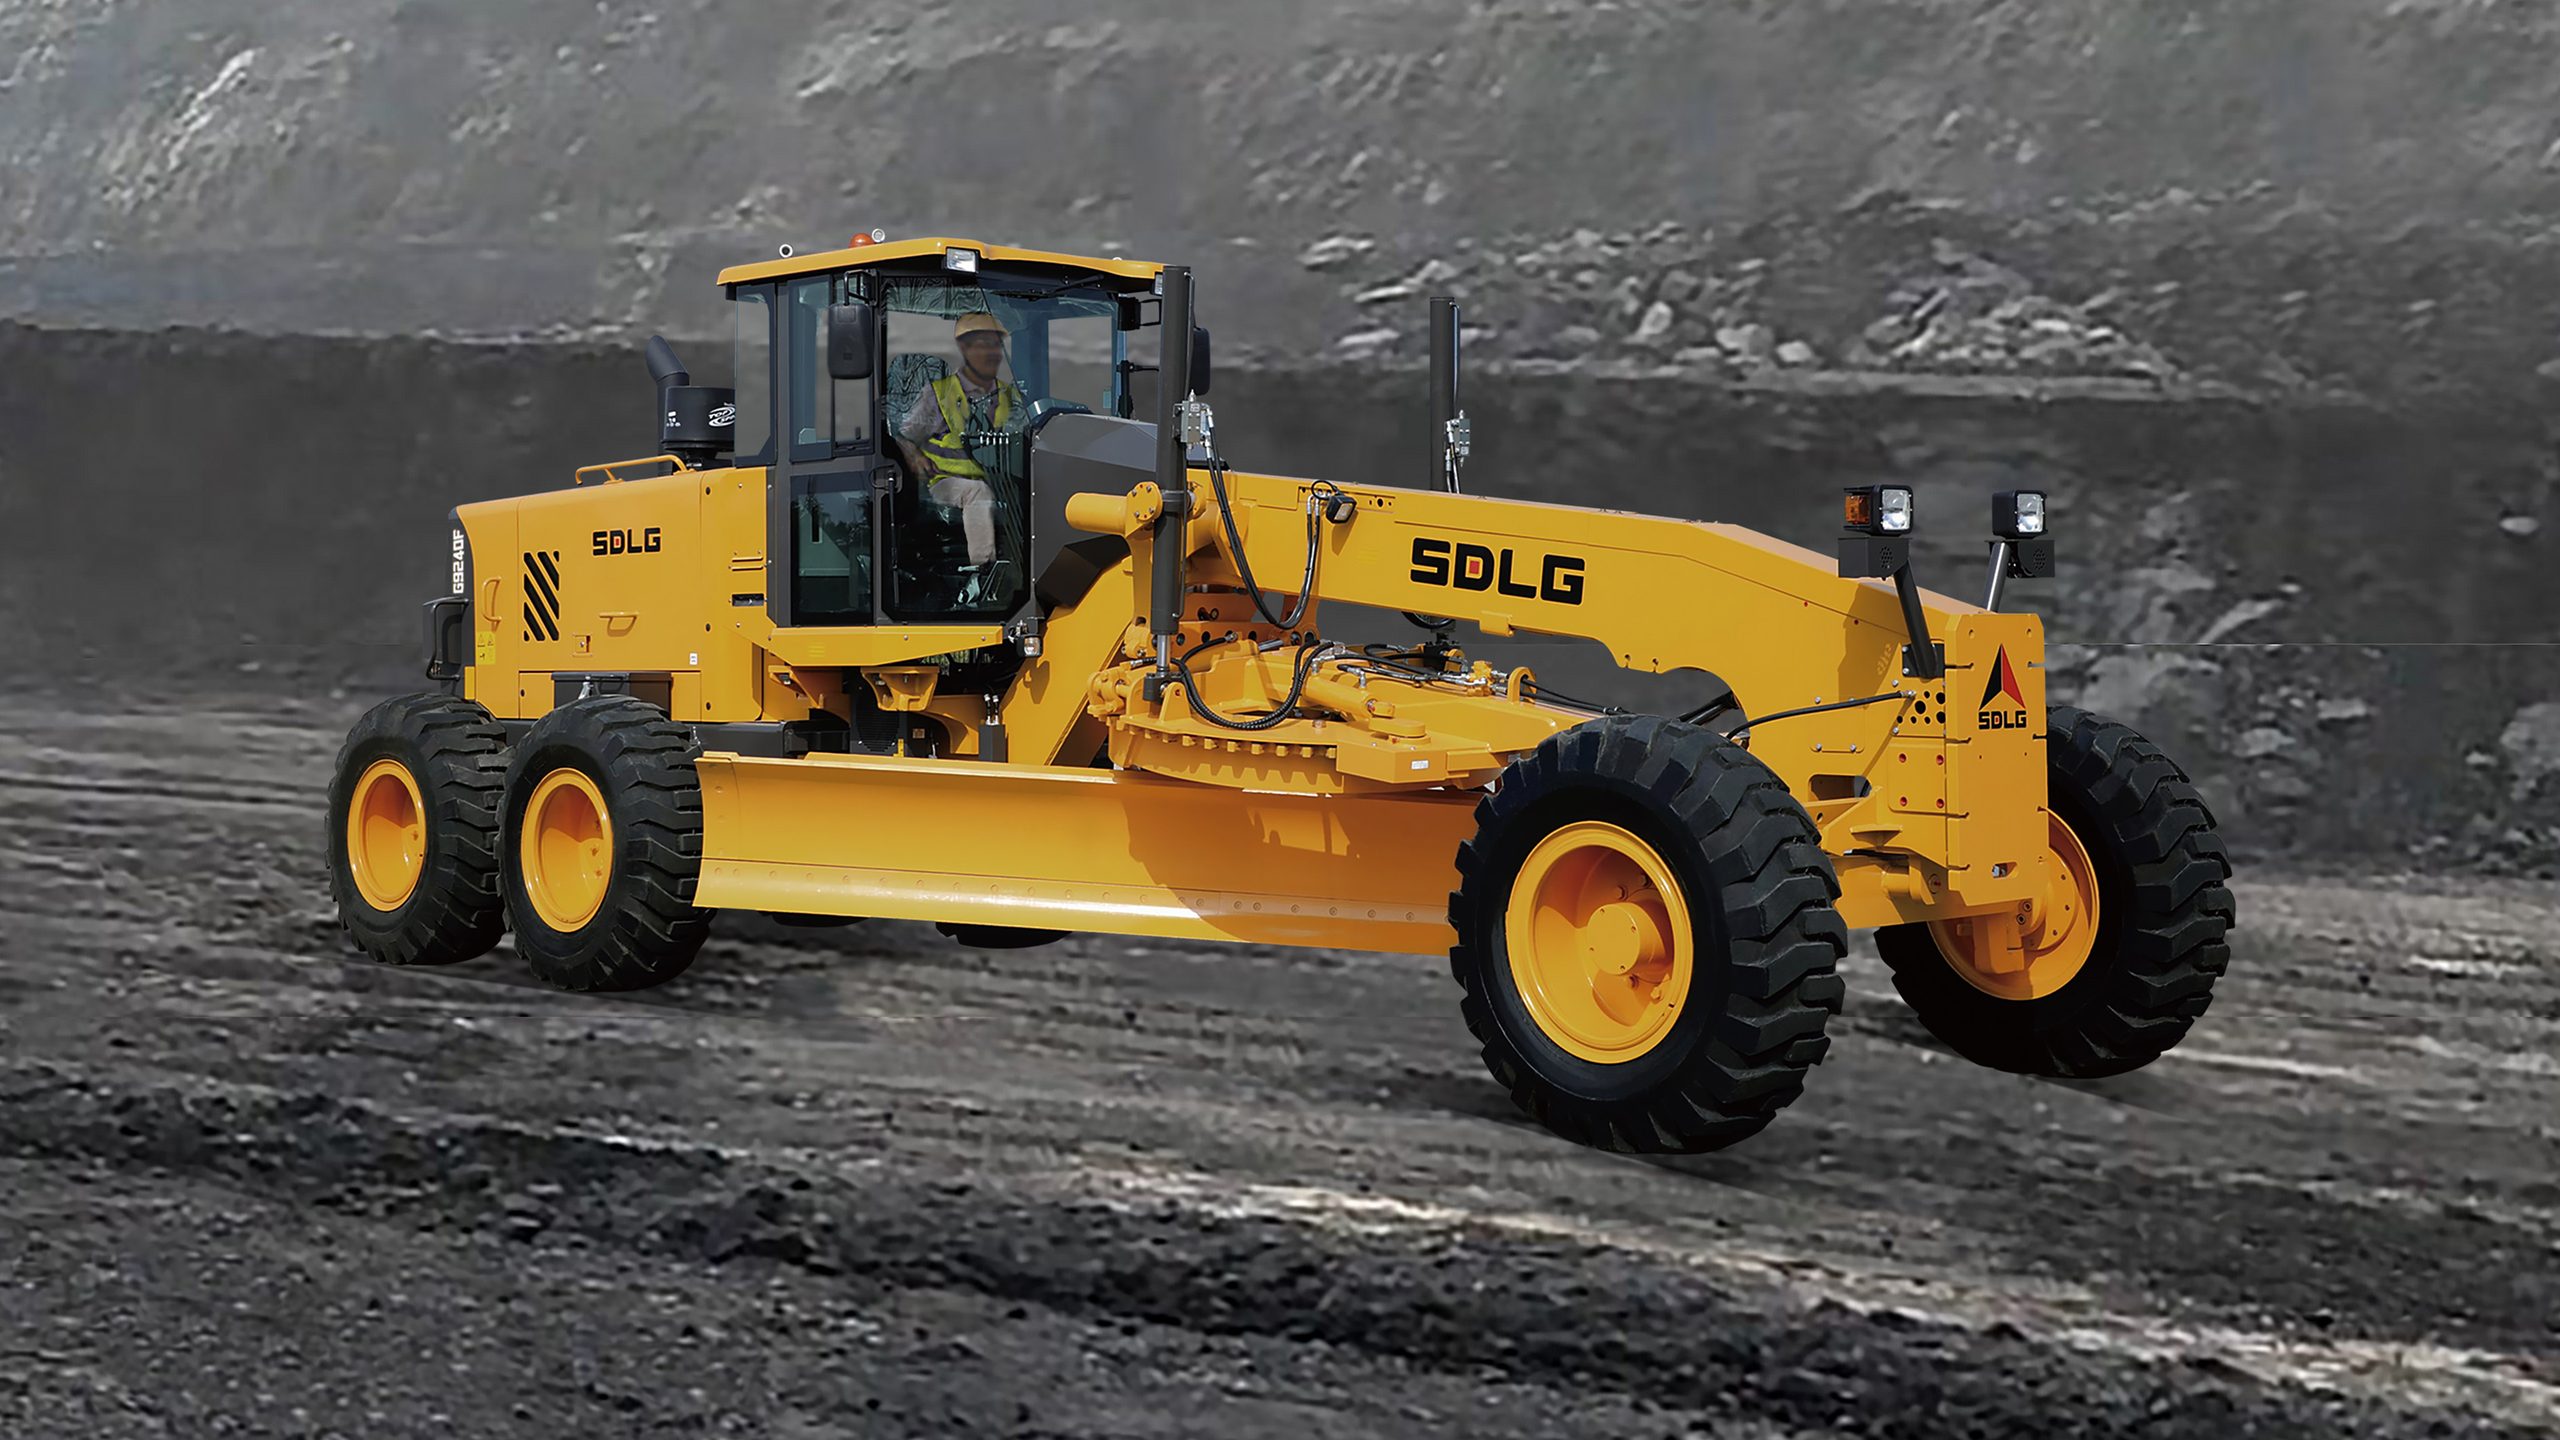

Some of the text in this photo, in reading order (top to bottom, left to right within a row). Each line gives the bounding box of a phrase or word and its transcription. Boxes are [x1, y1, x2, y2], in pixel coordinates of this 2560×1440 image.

[453, 529, 465, 594] G9240F
[592, 527, 662, 556] SDLG
[1410, 537, 1586, 606] SDLG
[1978, 710, 2027, 730] SDLG
